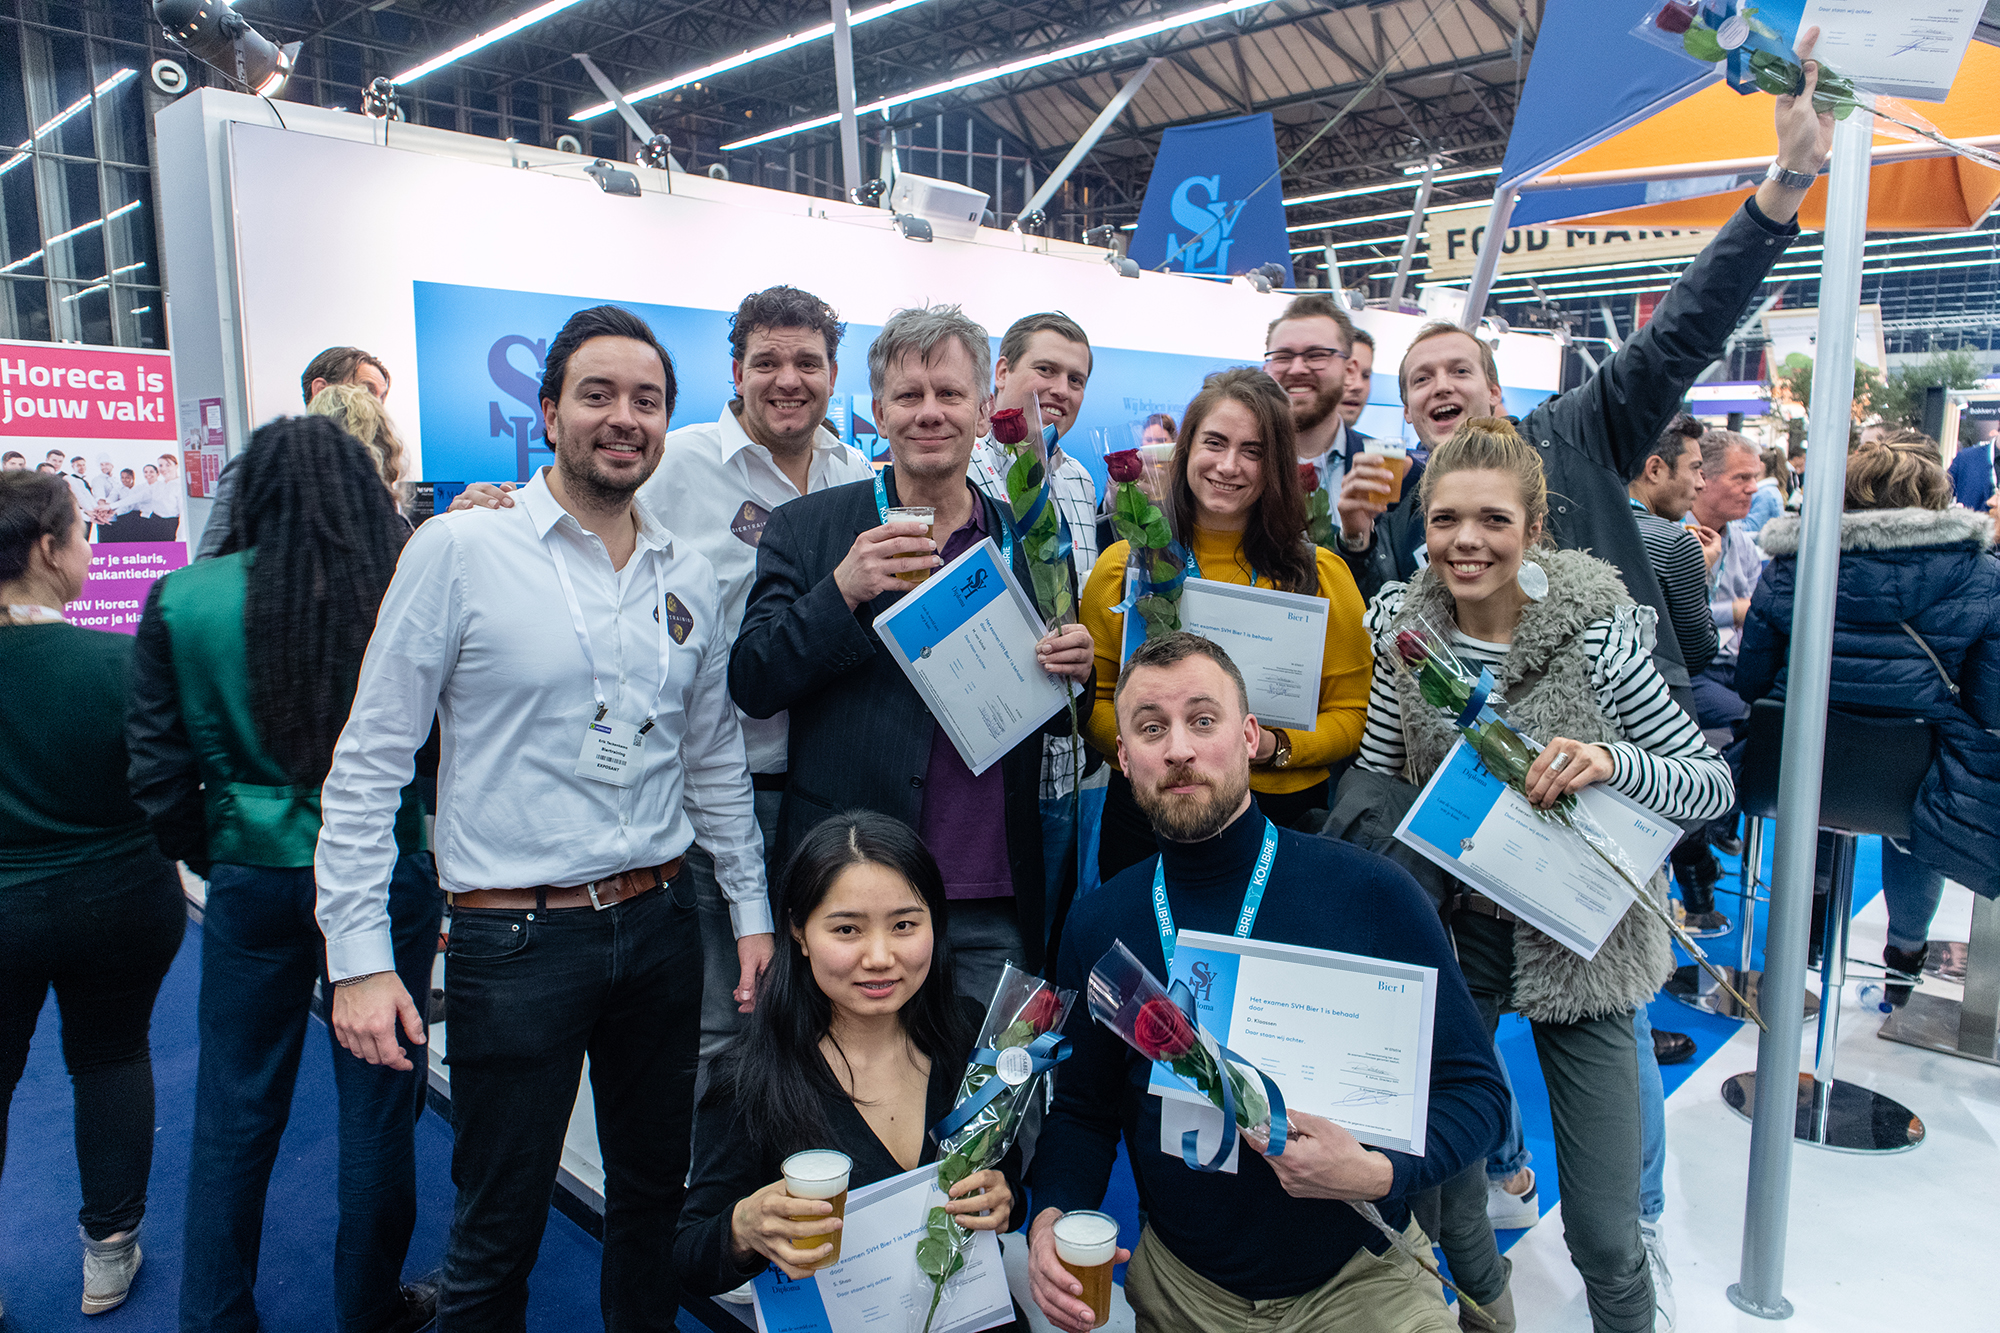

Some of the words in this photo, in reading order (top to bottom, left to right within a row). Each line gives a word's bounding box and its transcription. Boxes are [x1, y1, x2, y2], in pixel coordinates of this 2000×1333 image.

[0, 358, 126, 391] Horeca
[137, 366, 164, 393] is
[2, 389, 89, 424] jouw
[97, 395, 165, 422] vak!
[108, 554, 120, 567] je
[122, 553, 167, 565] salaris,
[65, 600, 92, 612] FNV
[95, 600, 139, 610] Horeca
[80, 616, 109, 626] voor
[111, 614, 123, 627] je
[1287, 612, 1303, 622] Bier
[1305, 615, 1309, 623] 1
[1252, 633, 1273, 642] behaald
[597, 763, 620, 772] EXPOSANT
[1462, 768, 1488, 787] Diploma
[1504, 812, 1515, 821] Daar
[1634, 819, 1651, 834] Bier
[1253, 838, 1275, 886] KOLIBRIE
[1154, 885, 1173, 937] KOLIBRIE
[1189, 961, 1218, 1002] SVH
[1378, 980, 1398, 992] Bier
[1401, 984, 1405, 993] 1
[1197, 1002, 1214, 1012] loma
[1250, 996, 1262, 1004] Het
[1263, 999, 1290, 1008] examen
[1291, 1002, 1304, 1010] SVH
[1306, 1005, 1319, 1013] Bier
[1332, 1009, 1360, 1019] behaald
[1254, 1018, 1277, 1026] Klaassen
[1276, 1034, 1285, 1042] wij
[1285, 1035, 1306, 1044] achter.
[840, 1252, 866, 1264] examen
[866, 1246, 880, 1255] SVH
[880, 1240, 892, 1249] Bier
[829, 1268, 844, 1276] door
[772, 1285, 801, 1295] Diploma
[836, 1290, 850, 1298] Daar
[850, 1285, 866, 1294] staan
[866, 1282, 875, 1290] wij
